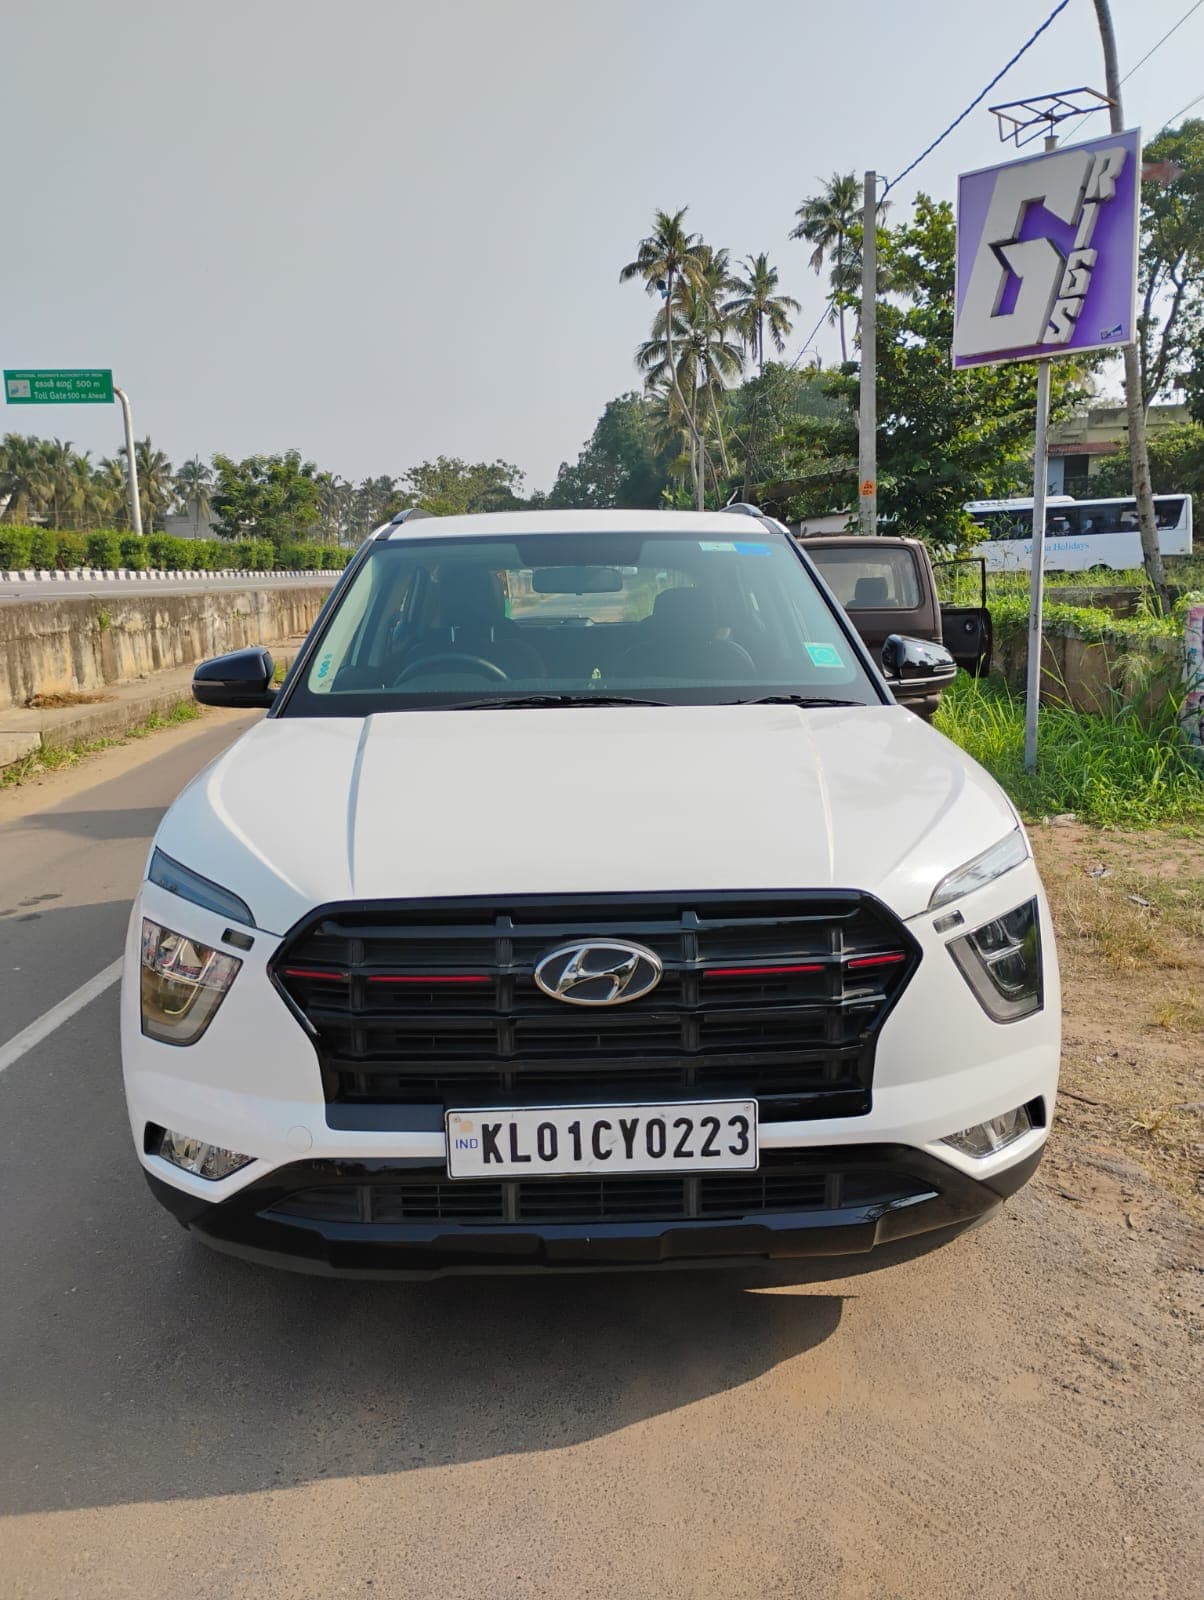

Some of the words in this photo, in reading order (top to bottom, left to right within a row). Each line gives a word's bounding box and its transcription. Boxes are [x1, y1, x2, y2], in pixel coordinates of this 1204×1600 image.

[76, 380, 92, 388] 500
[34, 392, 48, 400] Toll
[49, 392, 67, 400] Gate
[1054, 542, 1090, 552] Holidays
[455, 1138, 479, 1150] IND
[481, 1115, 750, 1164] KL01CY0223
